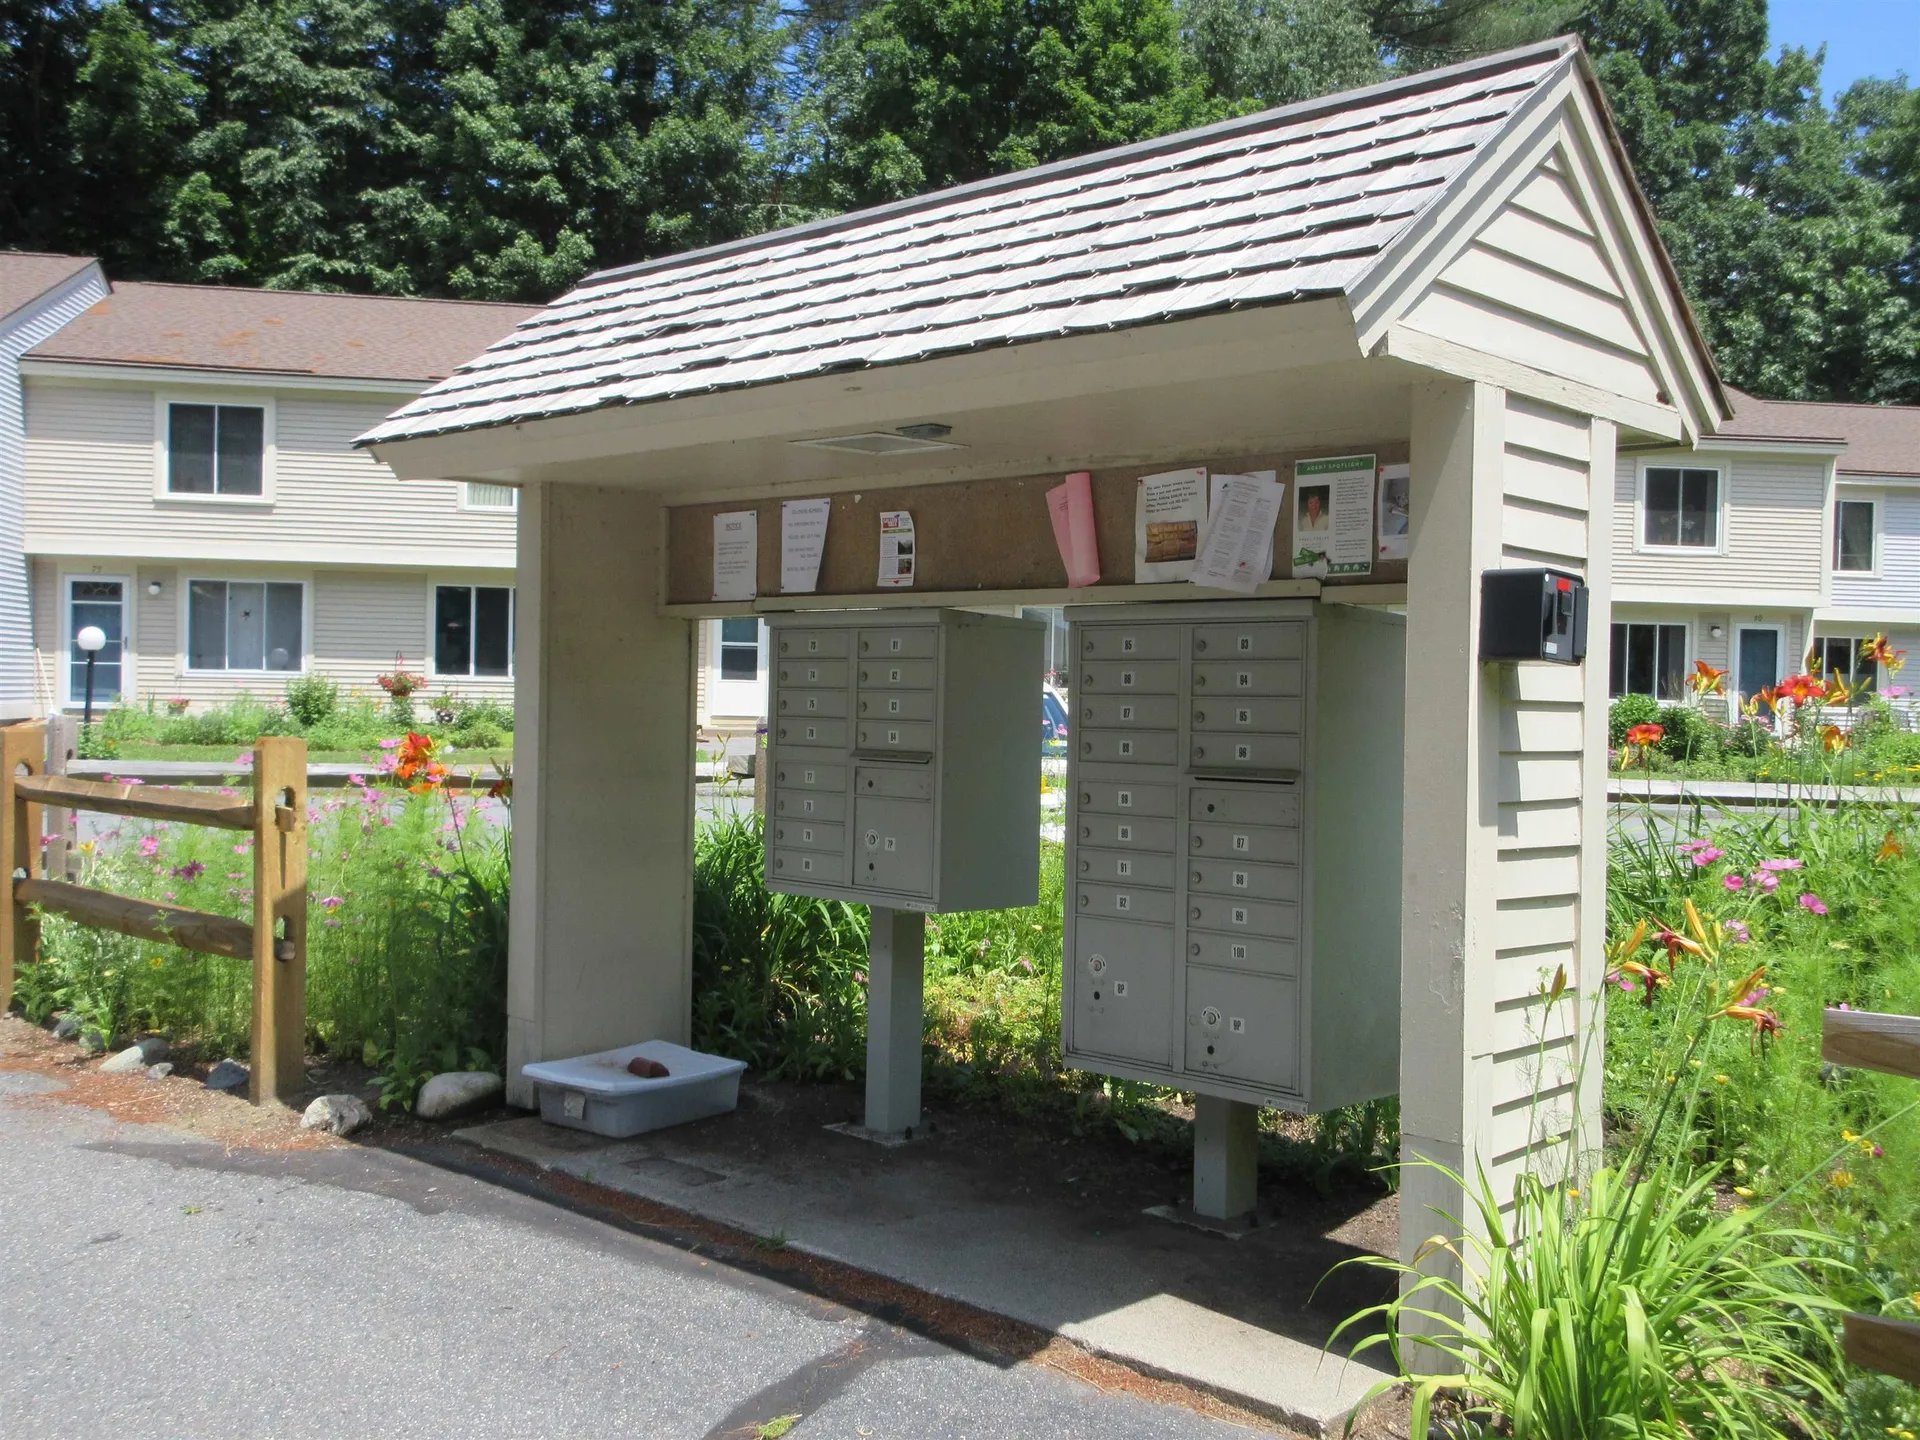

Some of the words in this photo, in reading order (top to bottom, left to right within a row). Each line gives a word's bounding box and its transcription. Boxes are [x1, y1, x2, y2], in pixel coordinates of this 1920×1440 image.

[893, 640, 898, 650] 81
[1125, 640, 1132, 650] 85
[1241, 638, 1249, 650] 93
[810, 671, 815, 679] 74
[892, 671, 898, 680] 82
[1240, 674, 1248, 685] 94
[809, 700, 814, 708] 75
[1123, 708, 1130, 718] 87
[1239, 711, 1247, 722] 95
[1238, 747, 1247, 758] 96
[807, 772, 812, 781] 77
[888, 840, 893, 848] 7P
[1237, 838, 1244, 848] 97
[1120, 862, 1127, 873] 91
[1236, 874, 1244, 885] 98
[1119, 898, 1127, 908] 92
[1235, 911, 1243, 922] 99
[1233, 947, 1244, 958] 100
